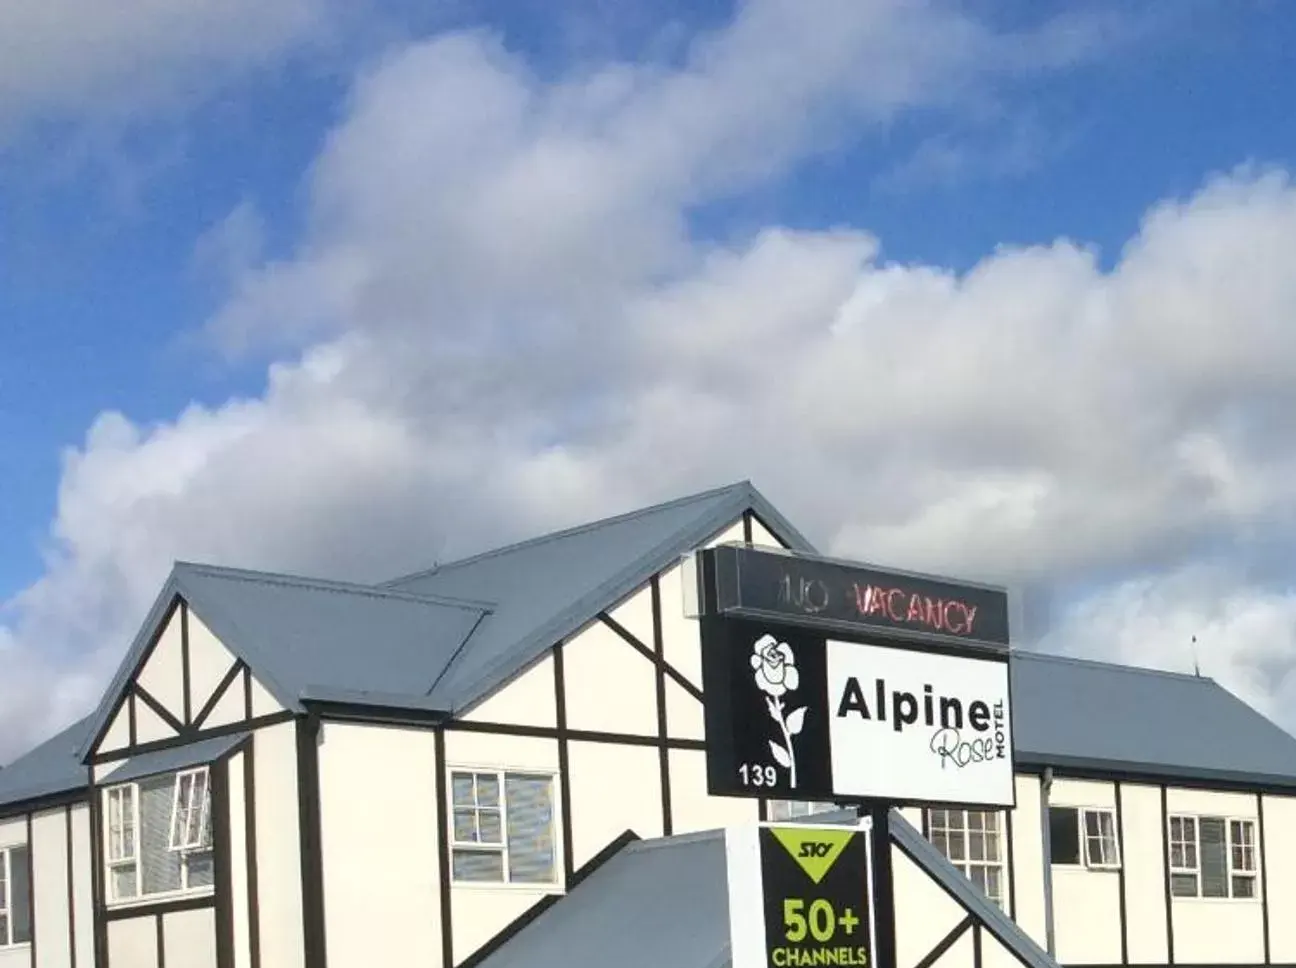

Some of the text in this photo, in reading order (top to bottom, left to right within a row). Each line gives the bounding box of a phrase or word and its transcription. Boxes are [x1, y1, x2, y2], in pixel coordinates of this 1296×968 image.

[778, 573, 977, 635] NO VACANCY
[837, 676, 992, 732] Alpine
[930, 727, 994, 769] Rose
[994, 699, 1006, 758] MOTEL
[739, 764, 777, 787] 139
[798, 843, 834, 857] SKY
[783, 898, 860, 942] 50+
[772, 947, 867, 967] CHANNELS
